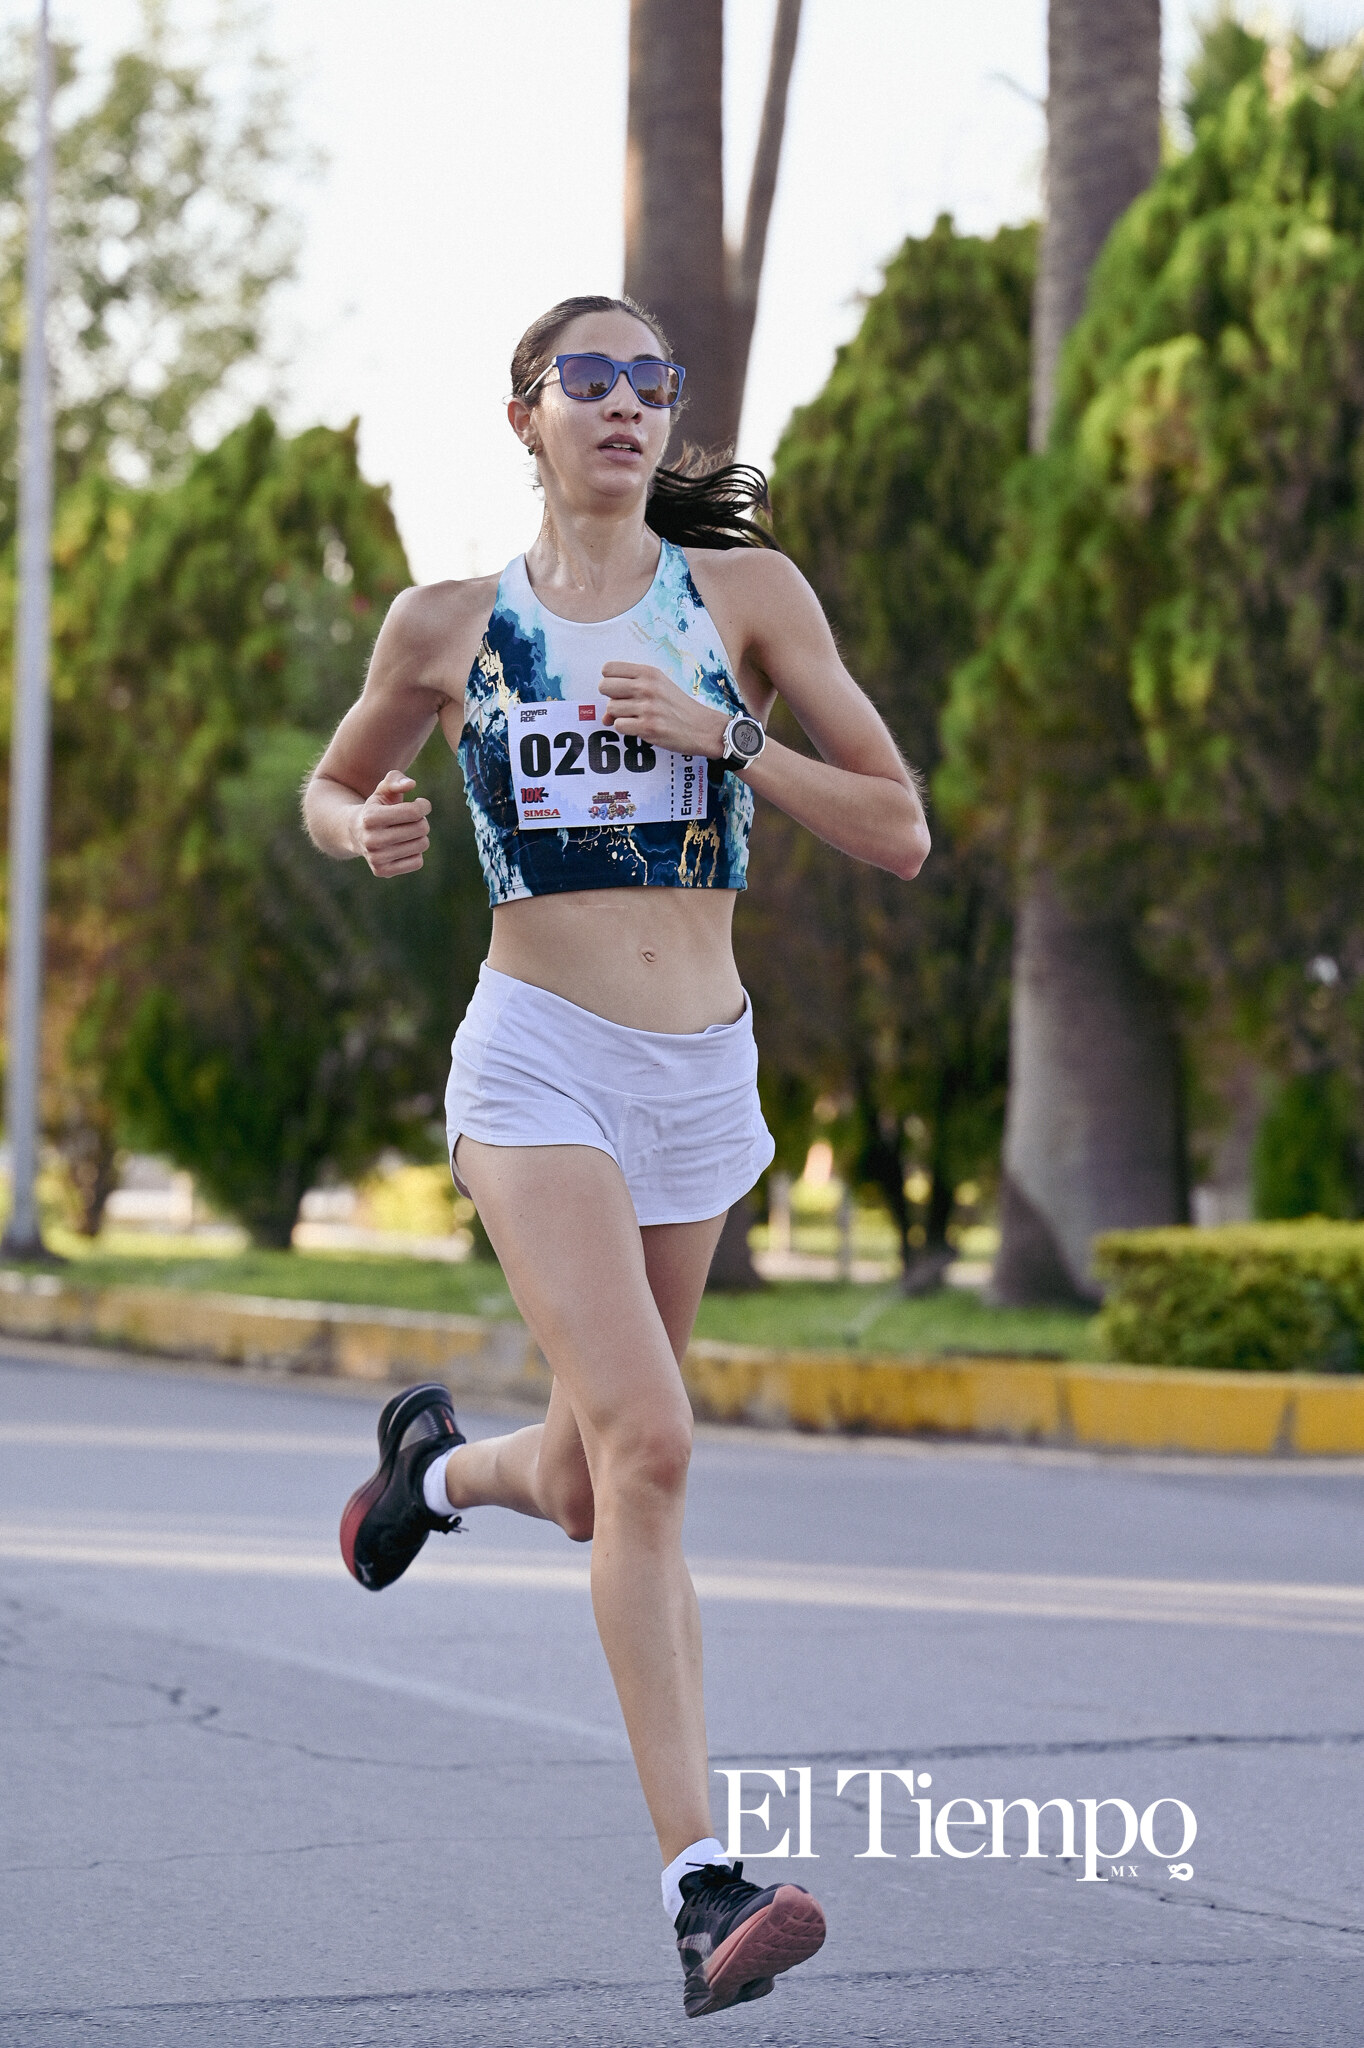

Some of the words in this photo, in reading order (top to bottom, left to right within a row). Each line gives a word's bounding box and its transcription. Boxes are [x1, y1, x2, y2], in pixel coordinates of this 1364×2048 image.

[520, 709, 547, 717] POWER
[519, 730, 657, 778] 0268
[682, 754, 693, 763] d
[520, 787, 546, 803] 10K
[681, 766, 695, 816] Entrega
[523, 808, 561, 818] SIMSA
